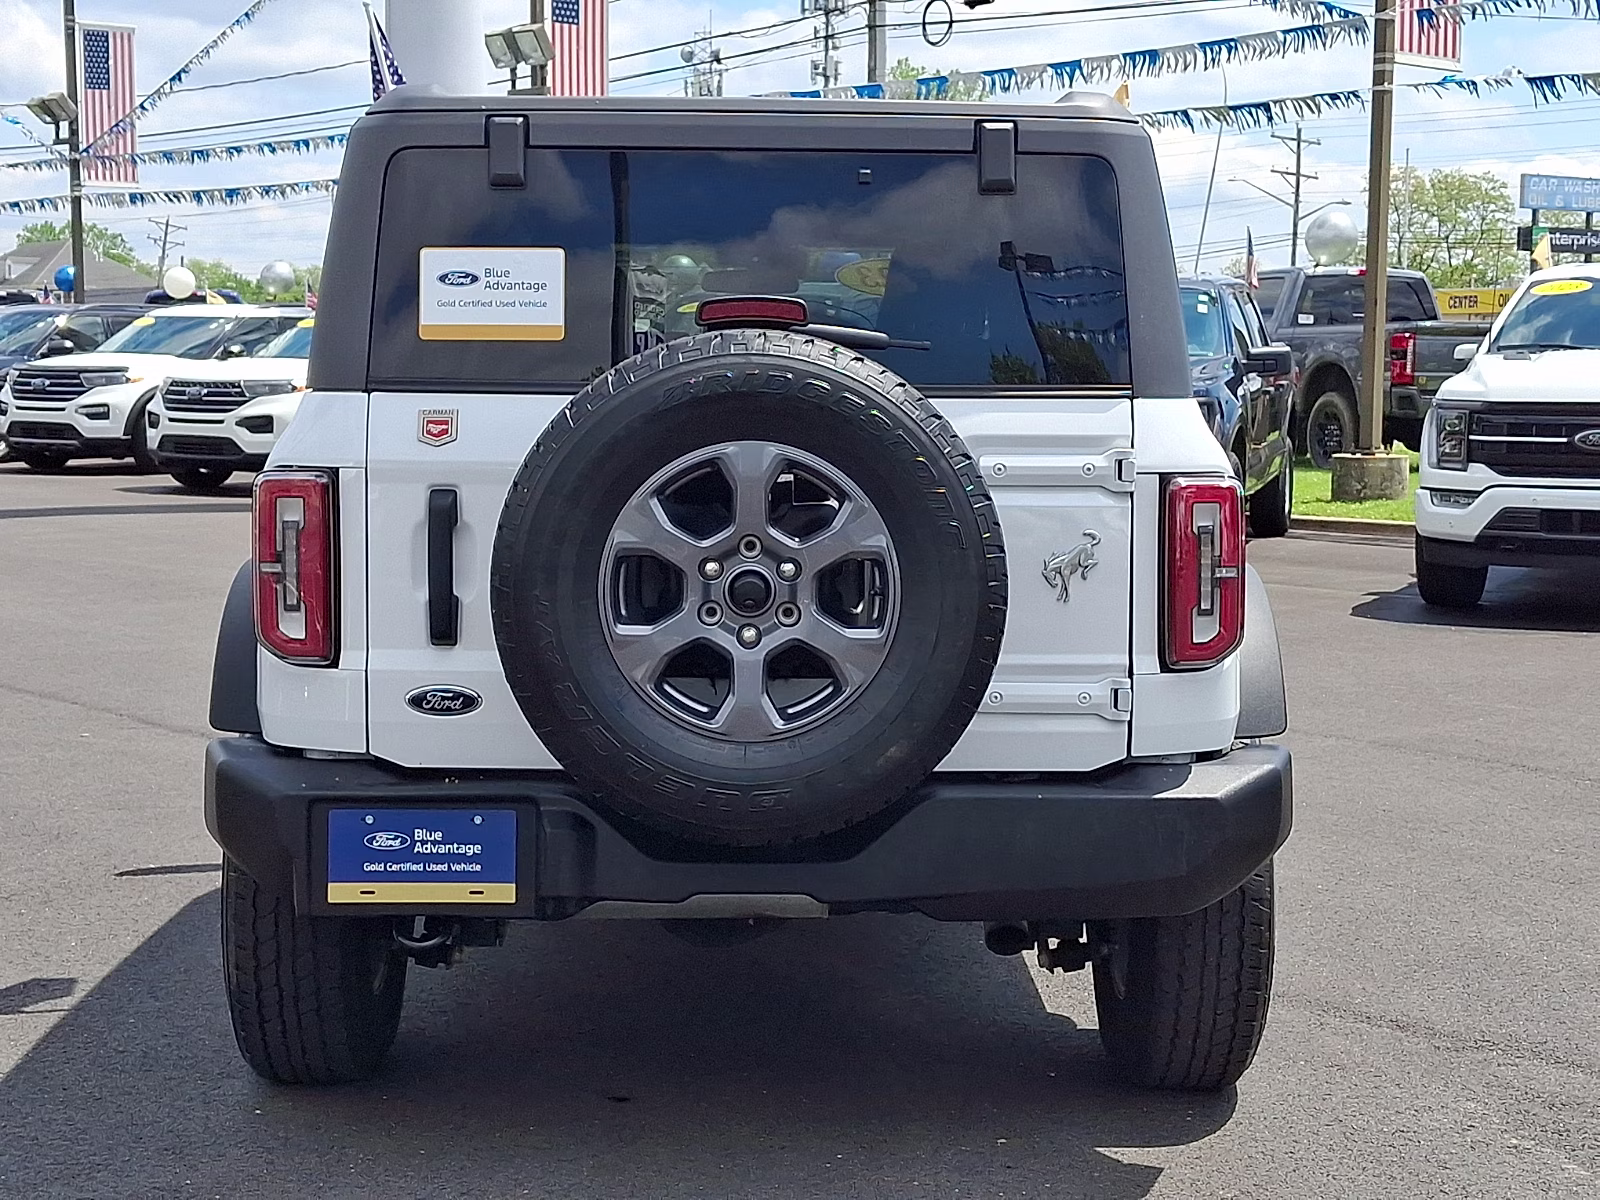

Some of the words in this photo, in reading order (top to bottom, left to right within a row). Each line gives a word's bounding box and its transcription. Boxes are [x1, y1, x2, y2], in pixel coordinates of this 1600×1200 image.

[1530, 177, 1558, 191] CAR
[1563, 180, 1600, 194] WASH
[1529, 193, 1548, 206] OIL
[1555, 195, 1565, 207] &
[483, 267, 511, 278] Blue
[483, 280, 548, 292] Advantage
[436, 299, 456, 308] Gold
[458, 299, 493, 308] Certified
[495, 299, 516, 308] Used
[519, 299, 548, 308] Vehicle
[1447, 295, 1479, 309] CENTER
[422, 691, 464, 710] Ford
[414, 828, 443, 841] Blue
[413, 842, 482, 856] Advantage
[363, 862, 385, 872] Gold
[386, 862, 424, 872] Certified
[425, 862, 448, 872] Used
[450, 862, 482, 872] Vehicle
